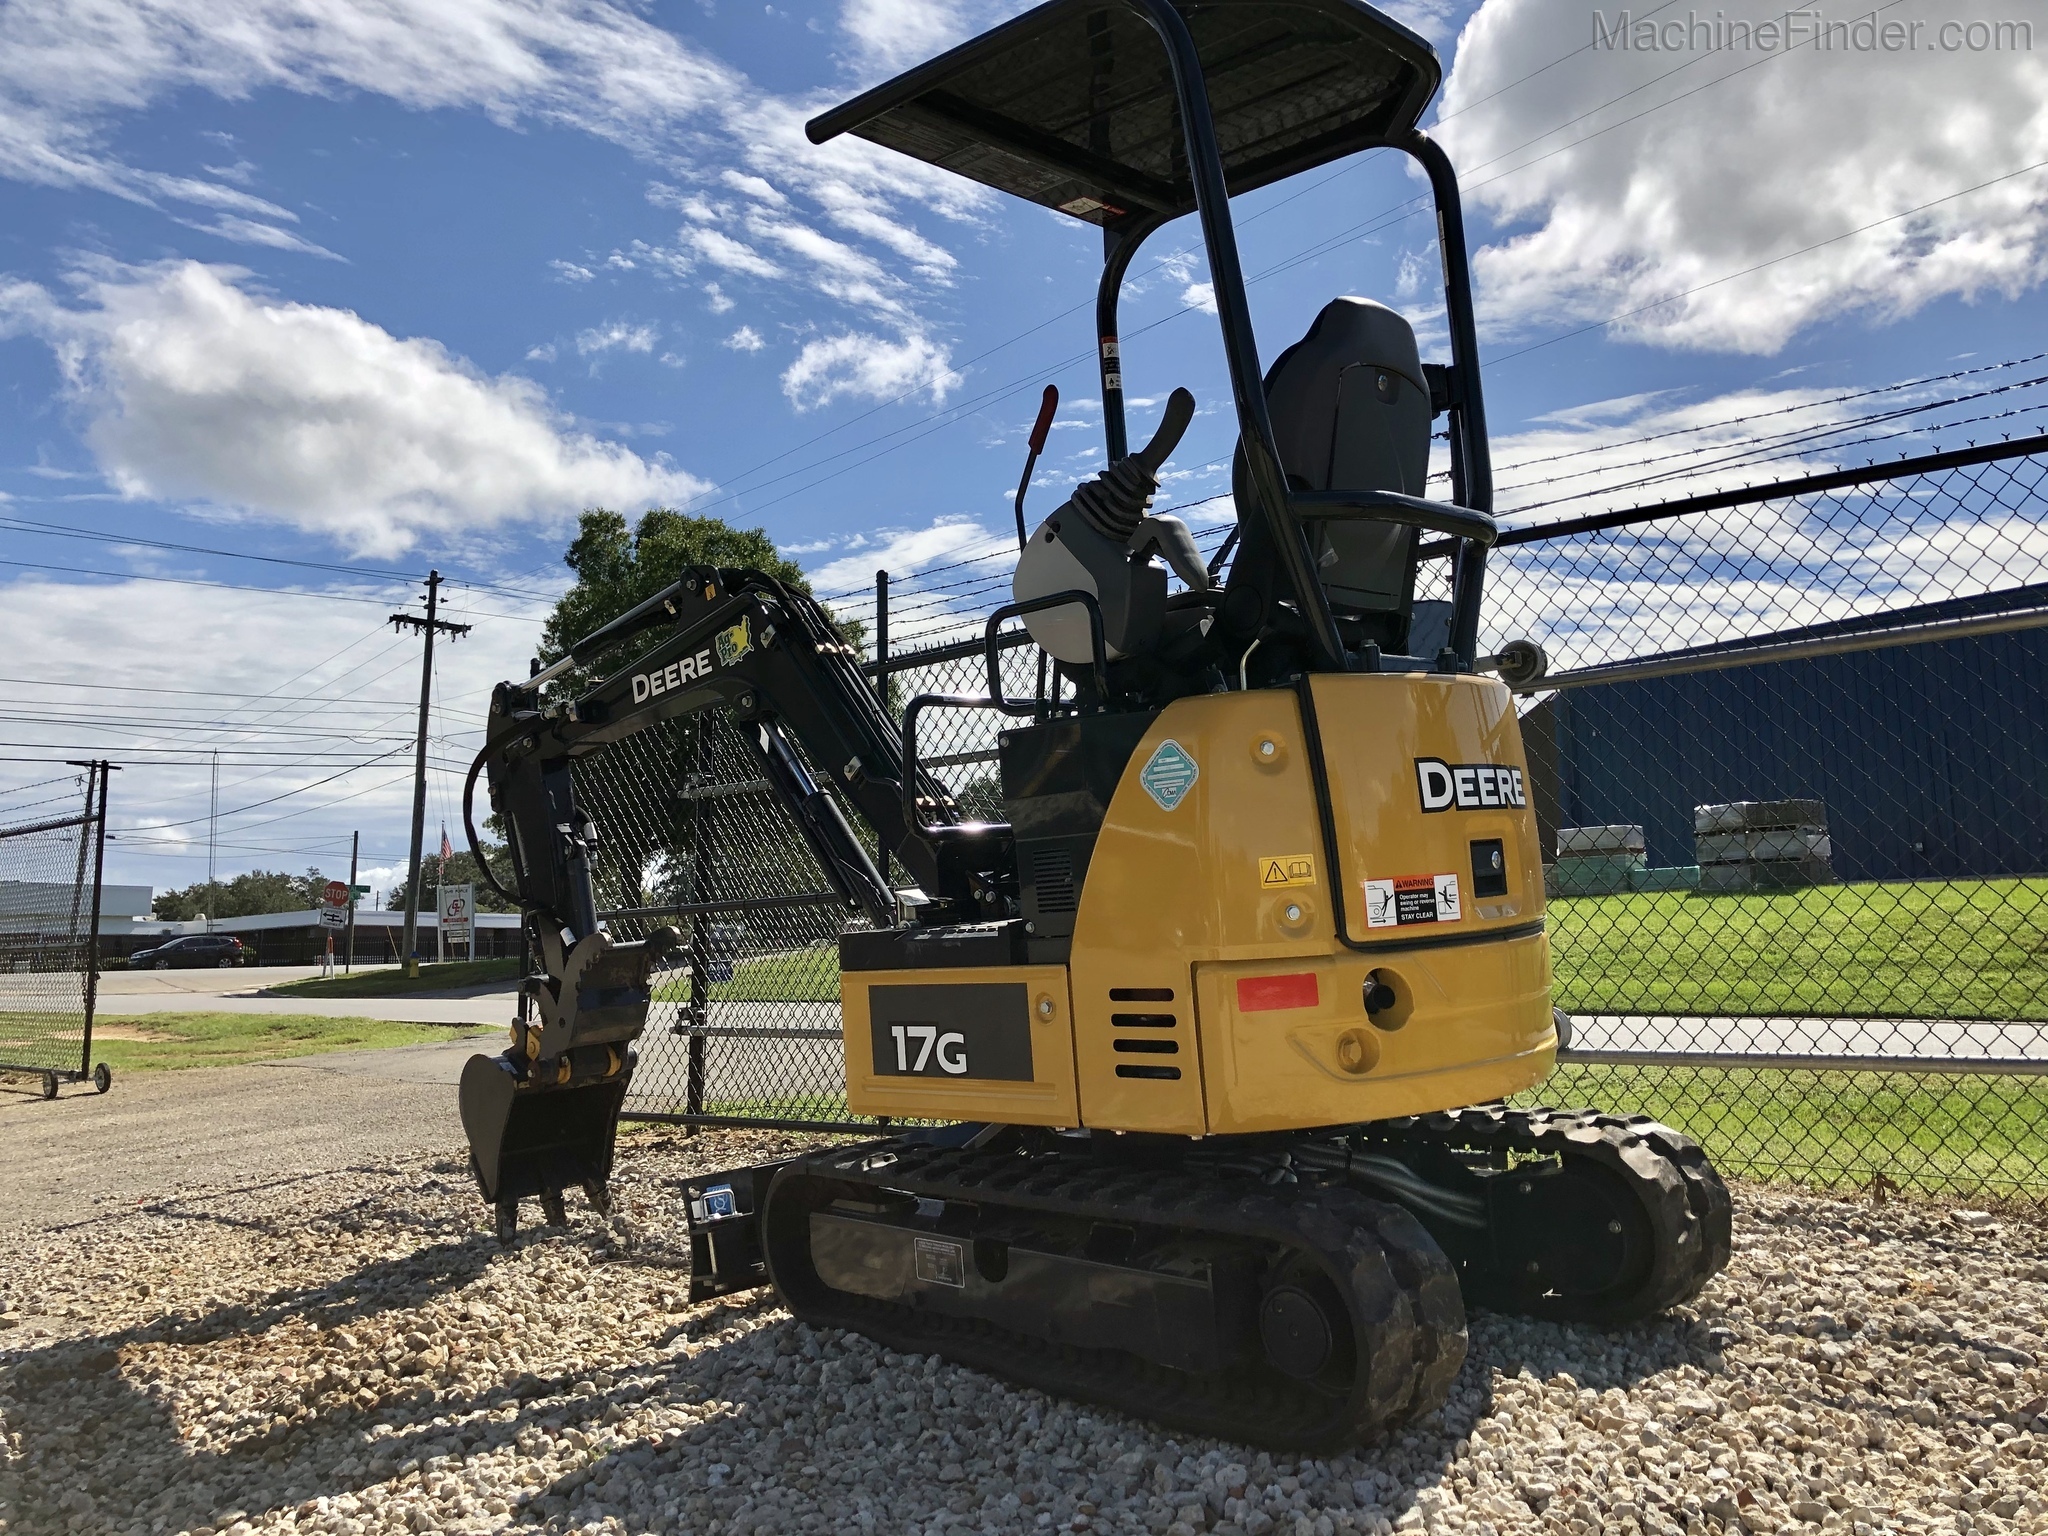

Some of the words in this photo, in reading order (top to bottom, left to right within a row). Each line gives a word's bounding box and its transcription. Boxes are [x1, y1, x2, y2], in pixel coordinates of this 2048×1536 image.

[631, 648, 713, 704] DEERE
[1416, 760, 1527, 809] DEERE
[325, 889, 348, 900] STOP
[1402, 879, 1433, 888] WARNING
[1401, 913, 1415, 921] STAY
[1416, 911, 1434, 919] CLEAR
[891, 1025, 967, 1074] 17G
